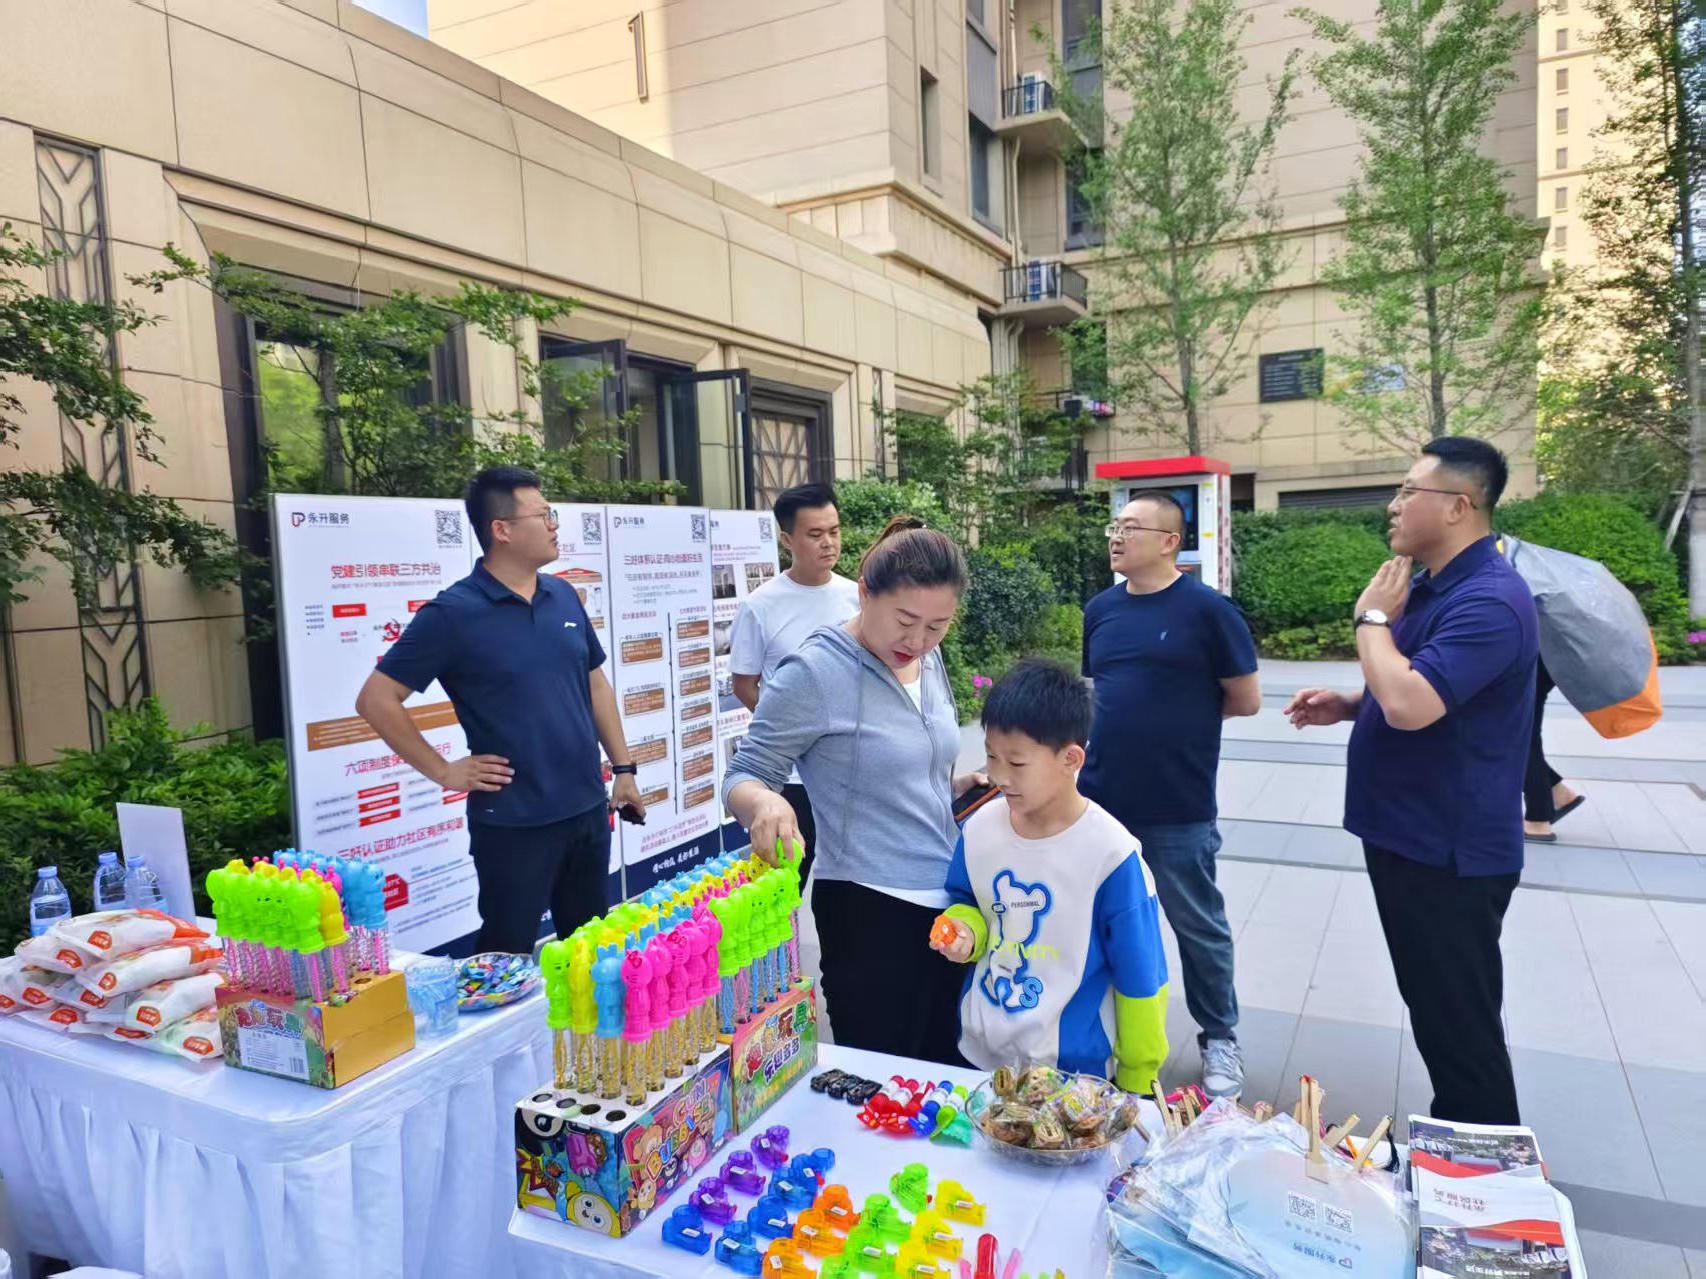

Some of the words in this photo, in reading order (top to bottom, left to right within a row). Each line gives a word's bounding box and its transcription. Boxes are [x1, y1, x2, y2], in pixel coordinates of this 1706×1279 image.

[308, 512, 350, 525] 永升服务
[331, 562, 440, 578] 党建引领串联三方共治
